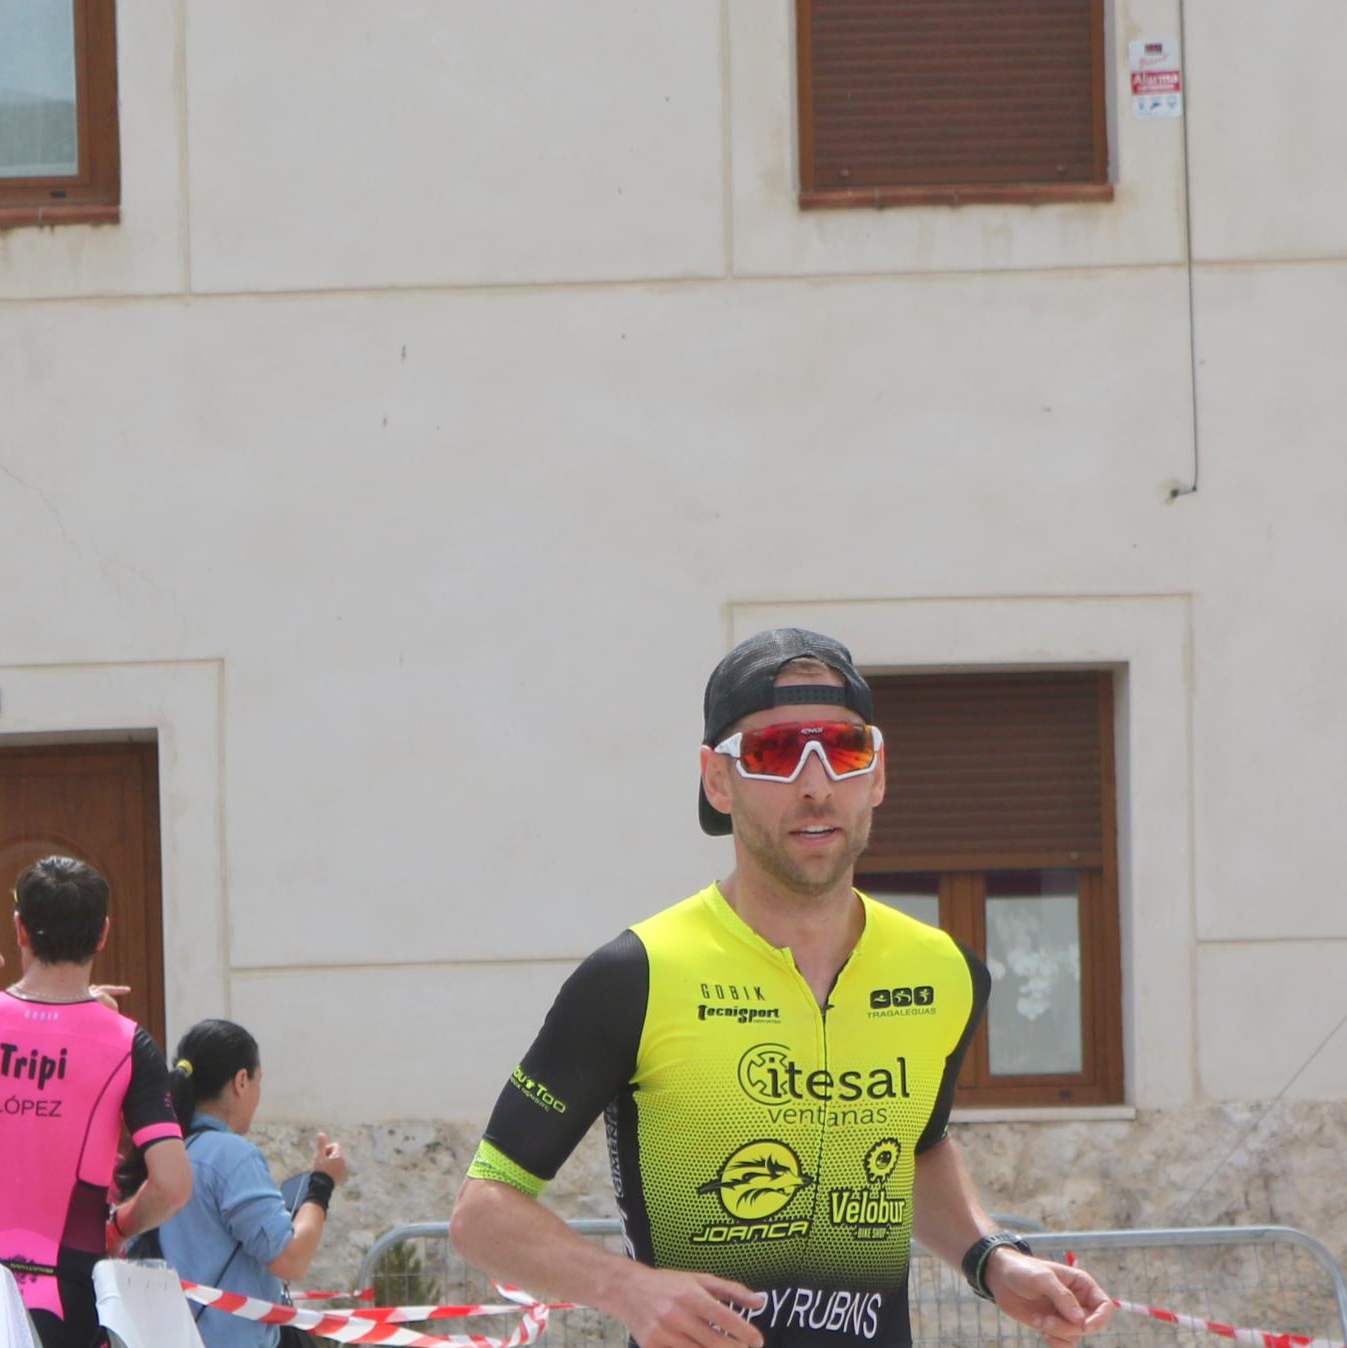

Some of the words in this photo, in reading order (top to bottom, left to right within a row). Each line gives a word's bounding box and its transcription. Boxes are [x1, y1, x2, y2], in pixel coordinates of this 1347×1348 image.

[700, 983, 766, 1001] GOBIK
[867, 1007, 937, 1020] TRAGALEGUAS
[0, 1042, 68, 1091] Tripi
[767, 1056, 910, 1102] itesal
[767, 1107, 888, 1127] ventanas
[692, 1220, 811, 1244] JOANCA
[787, 1288, 882, 1339] RUBNS
